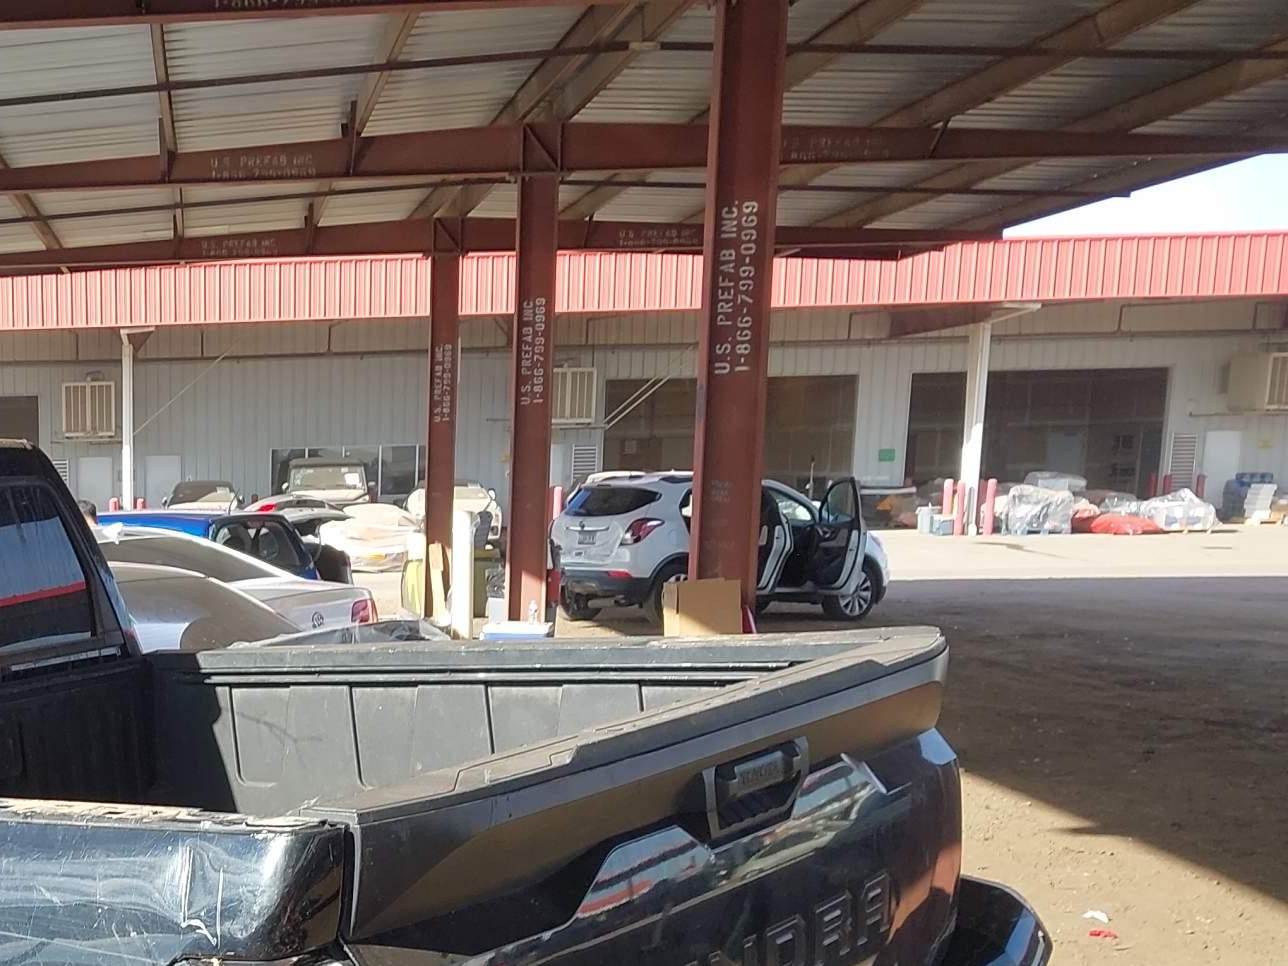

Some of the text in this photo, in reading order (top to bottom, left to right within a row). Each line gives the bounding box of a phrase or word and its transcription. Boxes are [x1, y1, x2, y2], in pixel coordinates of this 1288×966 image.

[521, 327, 533, 376] PREFAB
[533, 297, 546, 404] 1-866-799-0969
[714, 200, 739, 375] U.S. PREFAB INC.
[734, 201, 759, 372] 1-866-799-0969
